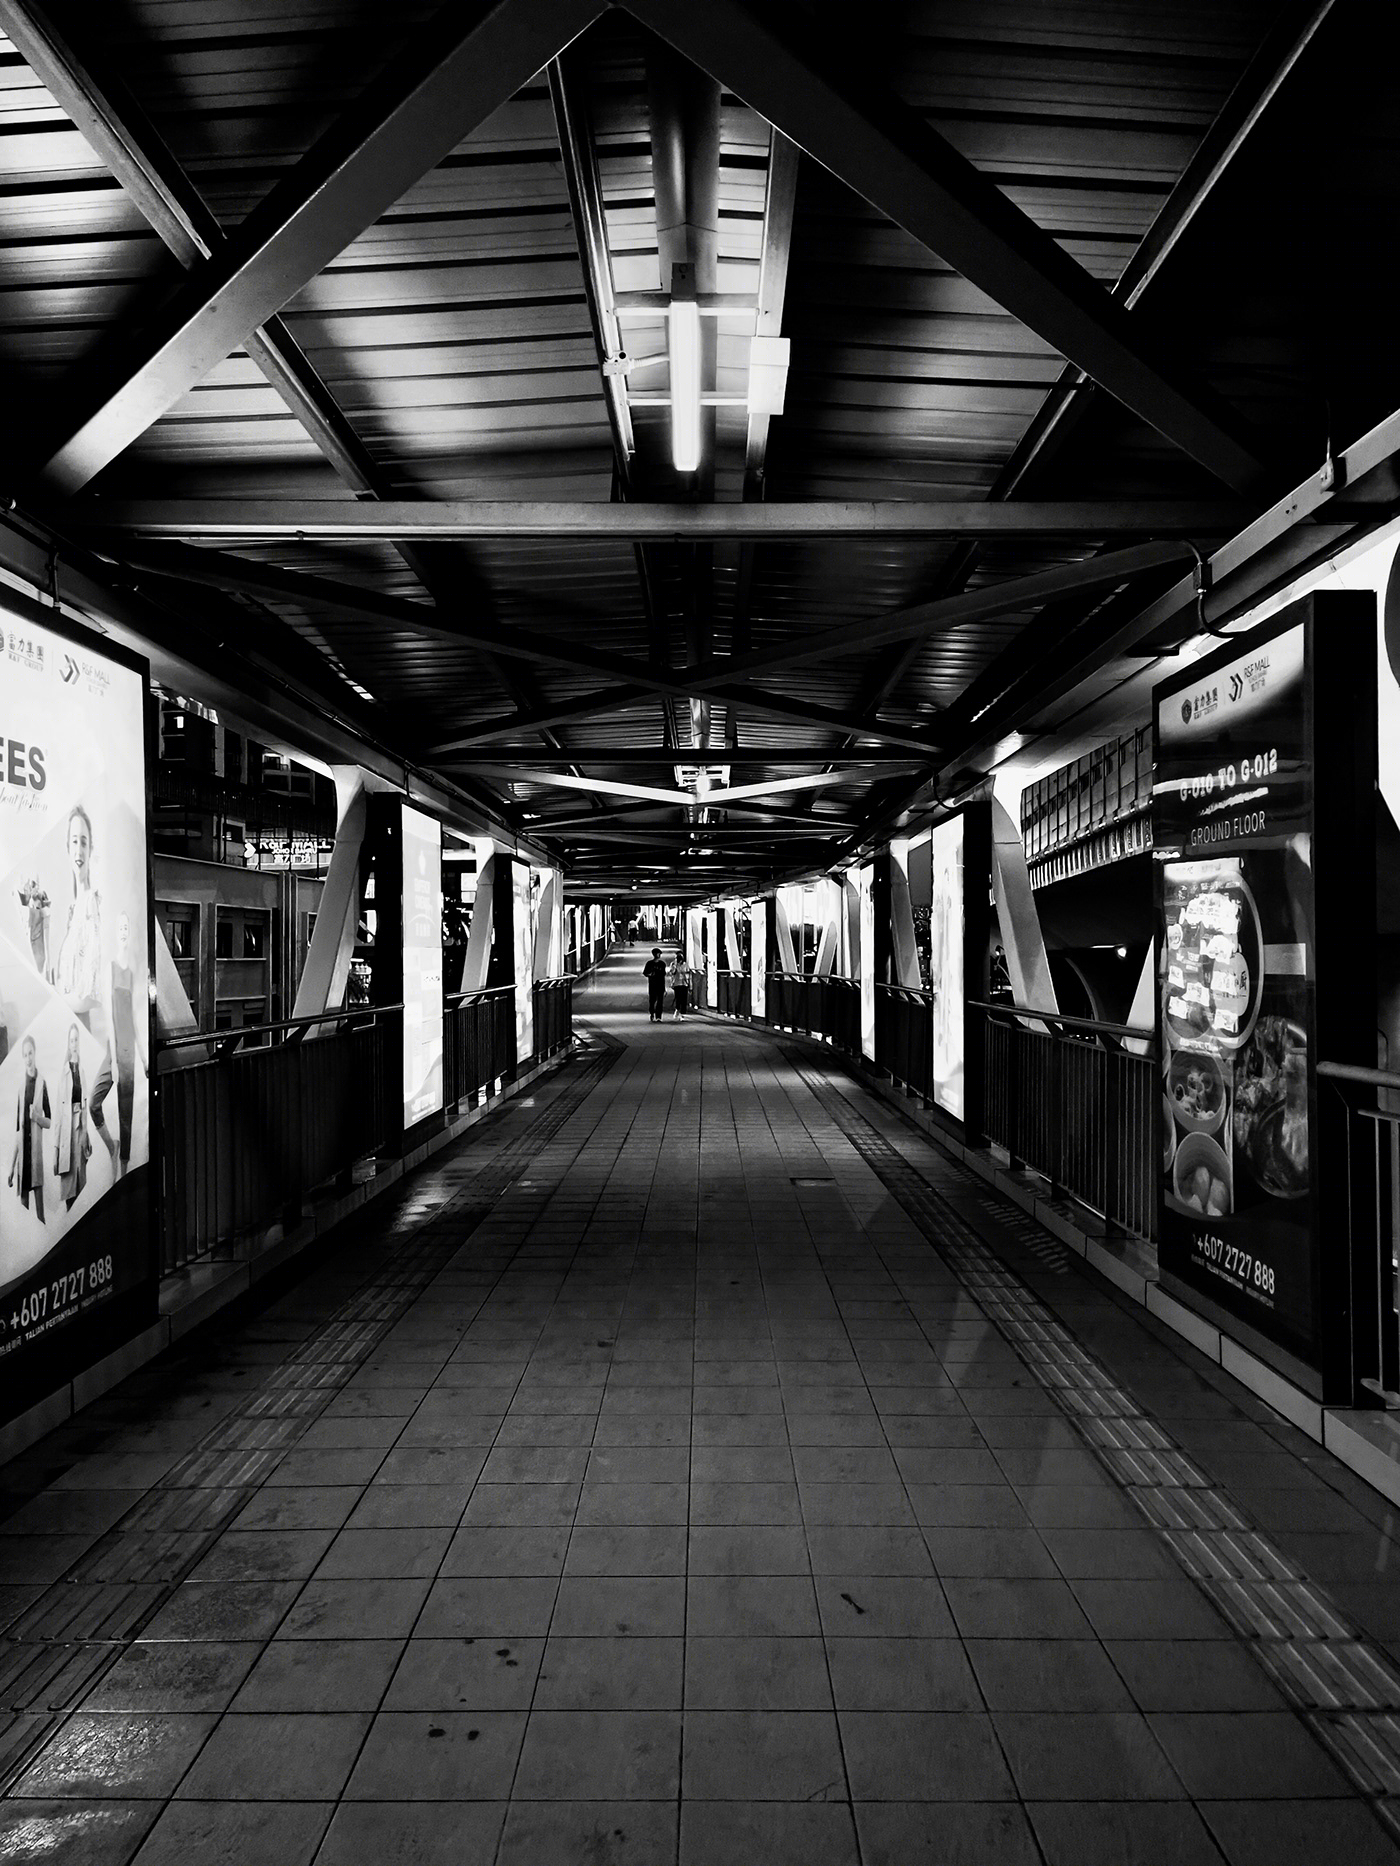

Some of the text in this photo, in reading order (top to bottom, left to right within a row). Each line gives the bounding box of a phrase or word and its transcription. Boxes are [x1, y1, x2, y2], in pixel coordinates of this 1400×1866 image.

[1254, 655, 1270, 672] MALL
[94, 668, 110, 685] MALL
[0, 736, 46, 791] ES
[1218, 766, 1236, 791] TO
[1191, 810, 1266, 846] GROUND FLOOR
[291, 838, 331, 849] MALL
[1197, 1233, 1223, 1263] +607
[1224, 1244, 1252, 1280] 2727
[1254, 1260, 1275, 1294] 888
[10, 1254, 113, 1329] +607 2727 888
[24, 1323, 45, 1341] TALIAN
